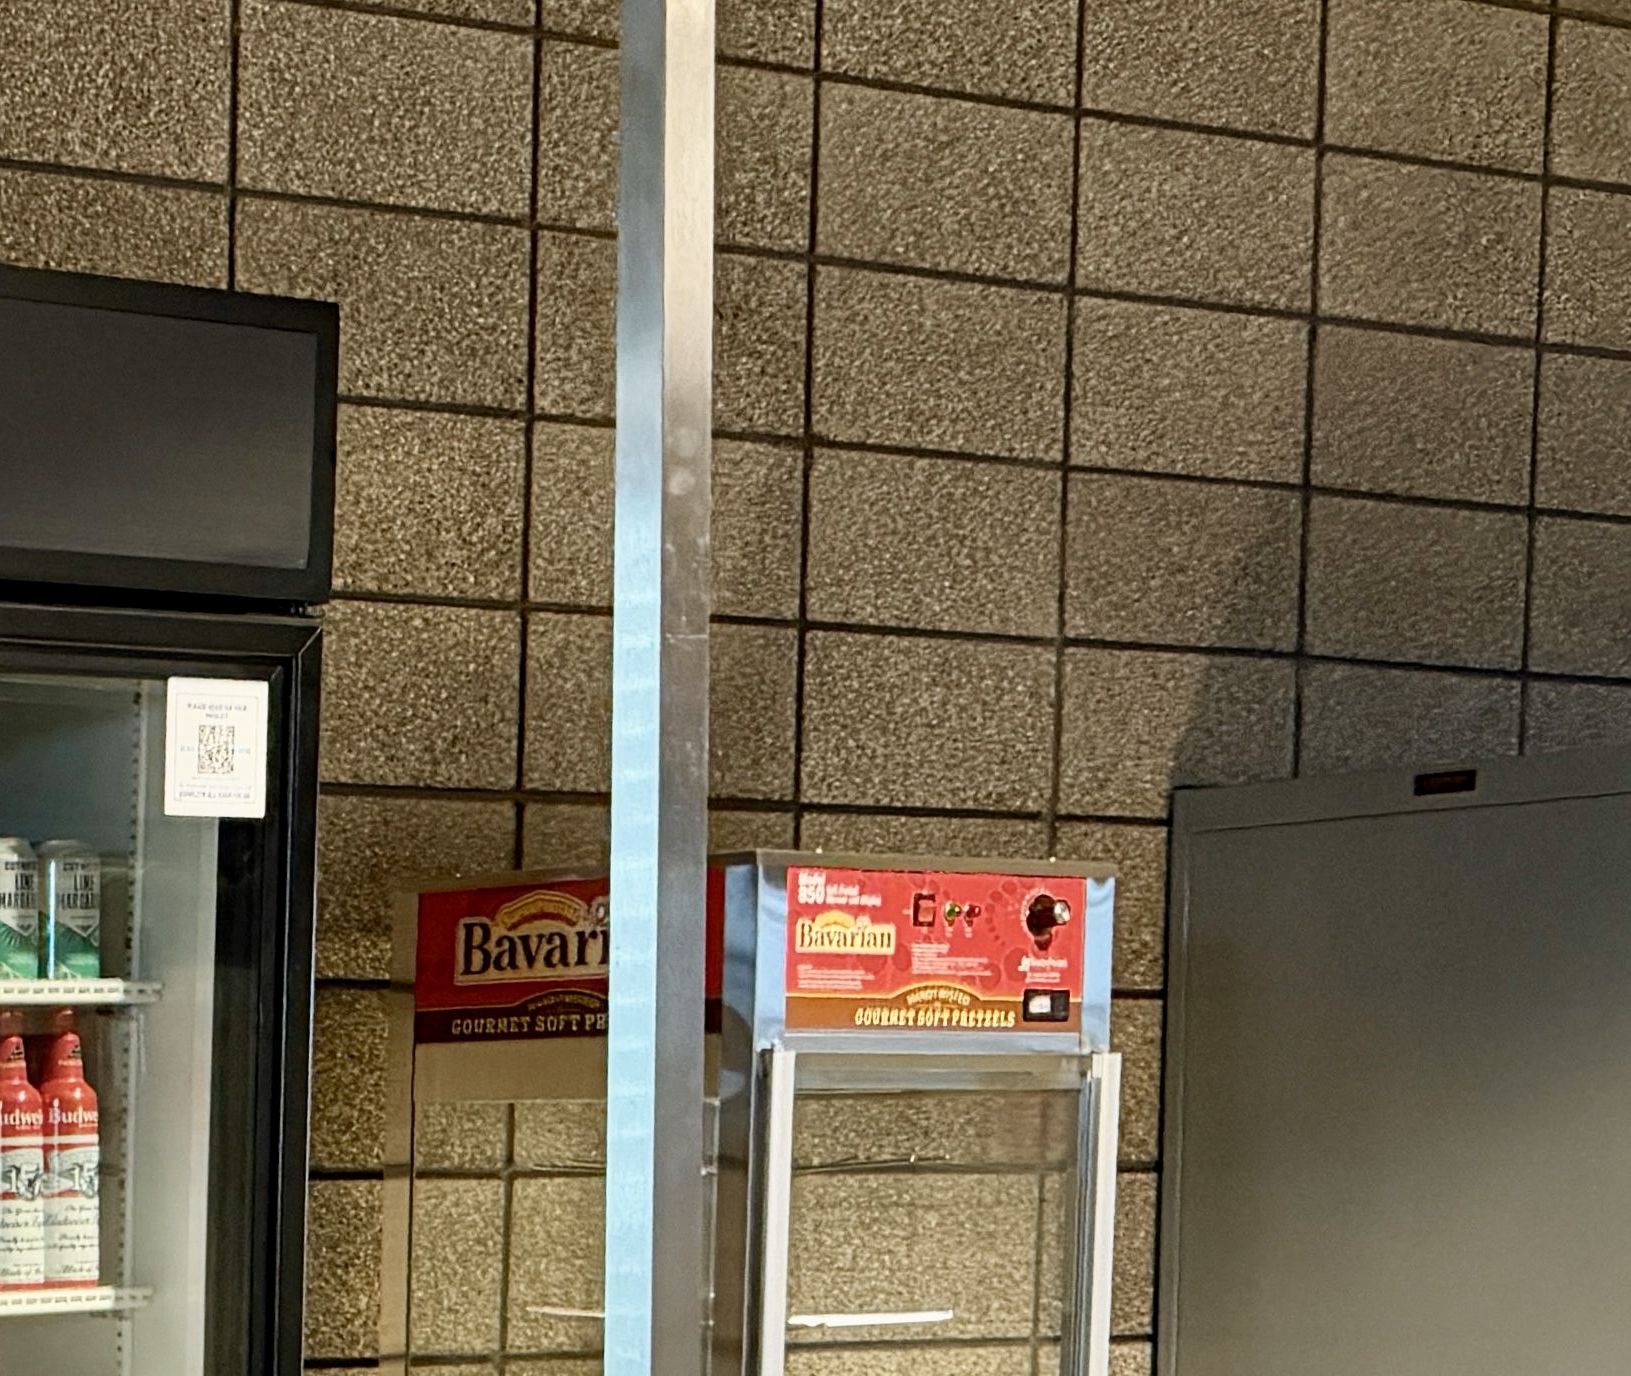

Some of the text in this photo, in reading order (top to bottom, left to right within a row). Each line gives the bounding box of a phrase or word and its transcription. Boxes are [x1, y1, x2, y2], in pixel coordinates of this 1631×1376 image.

[799, 921, 893, 949] Bavarian
[460, 921, 609, 976] Bavari
[534, 1014, 582, 1033] SOFT
[854, 1007, 1016, 1028] GOURMET SOFT PRETZELS
